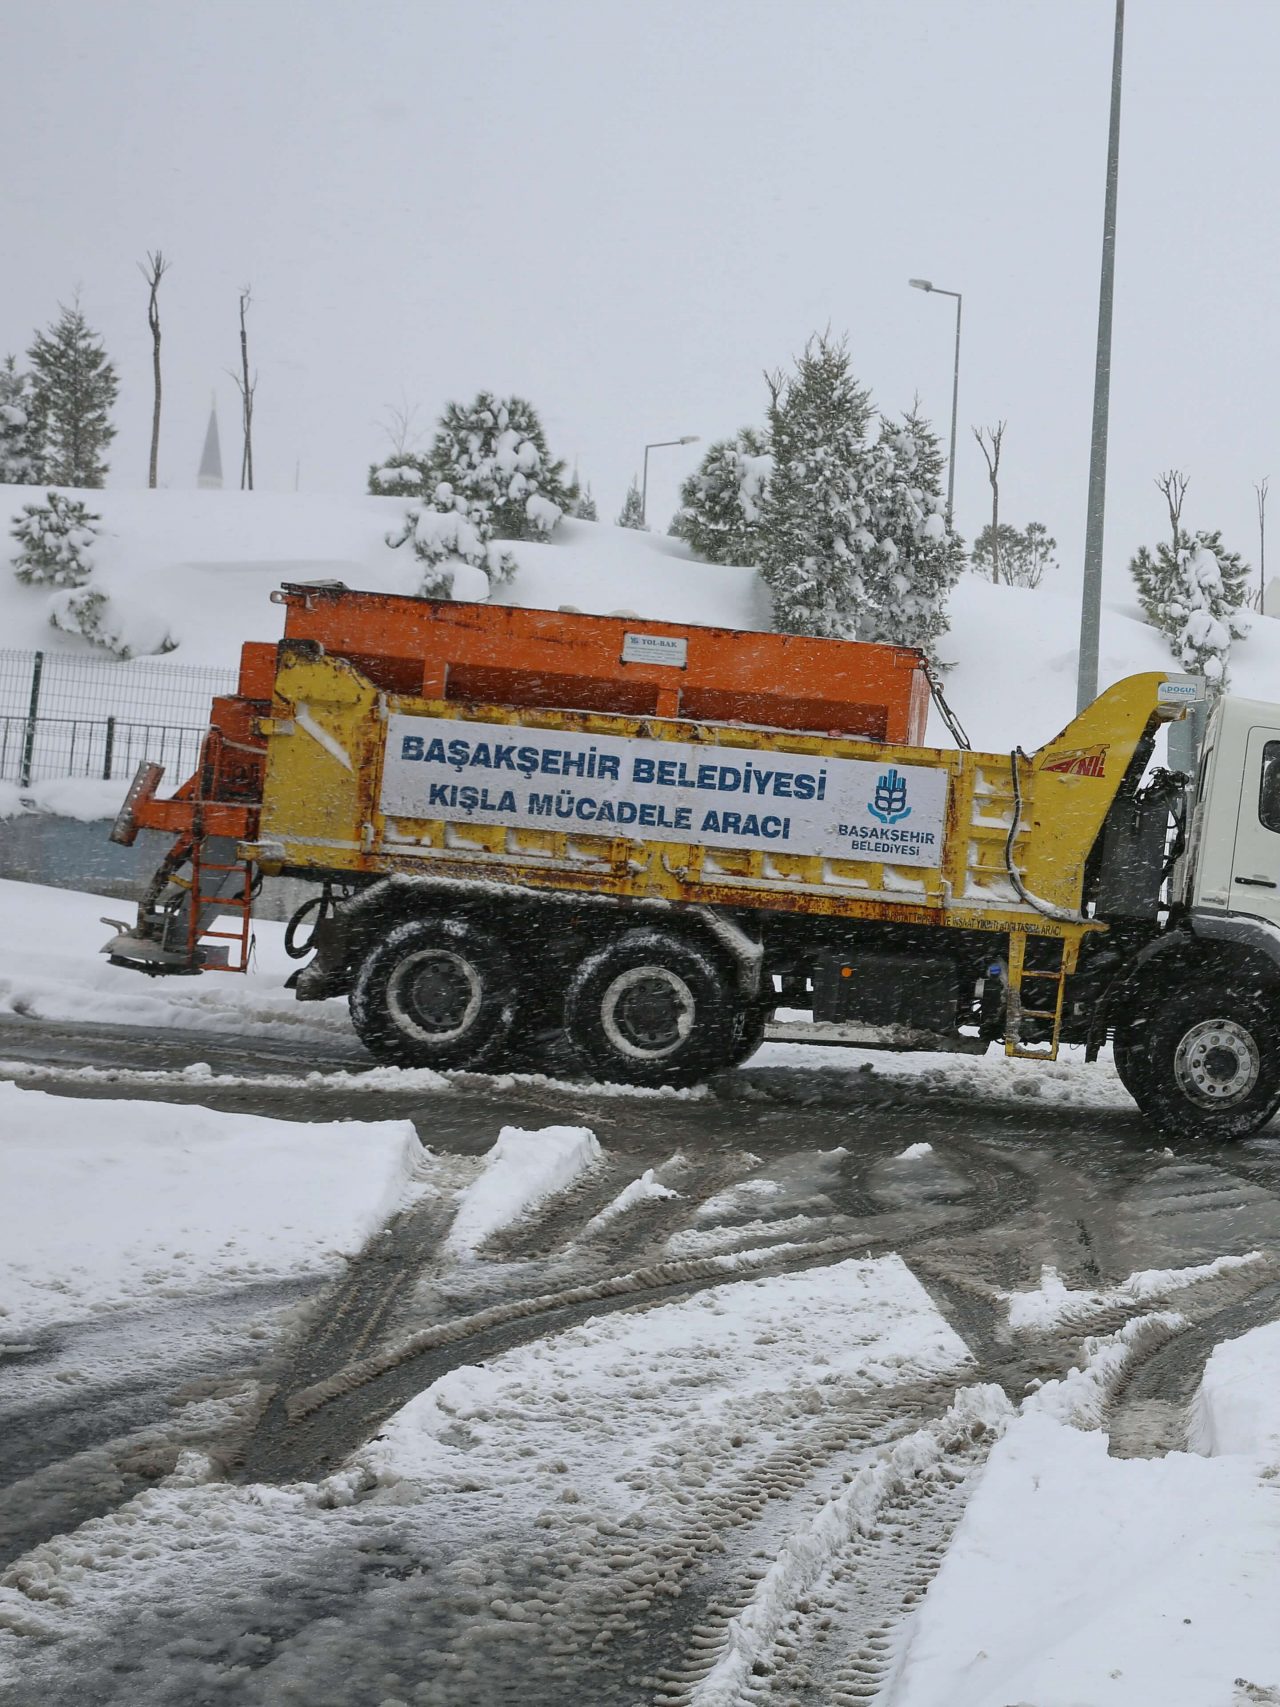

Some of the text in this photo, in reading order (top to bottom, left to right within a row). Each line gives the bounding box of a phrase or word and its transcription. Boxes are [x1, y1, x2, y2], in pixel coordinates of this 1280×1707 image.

[401, 735, 827, 800] BAŞAKŞEHİR BELEDİYESİ
[428, 783, 791, 839] KIŞLA MÜCADELE ARACI
